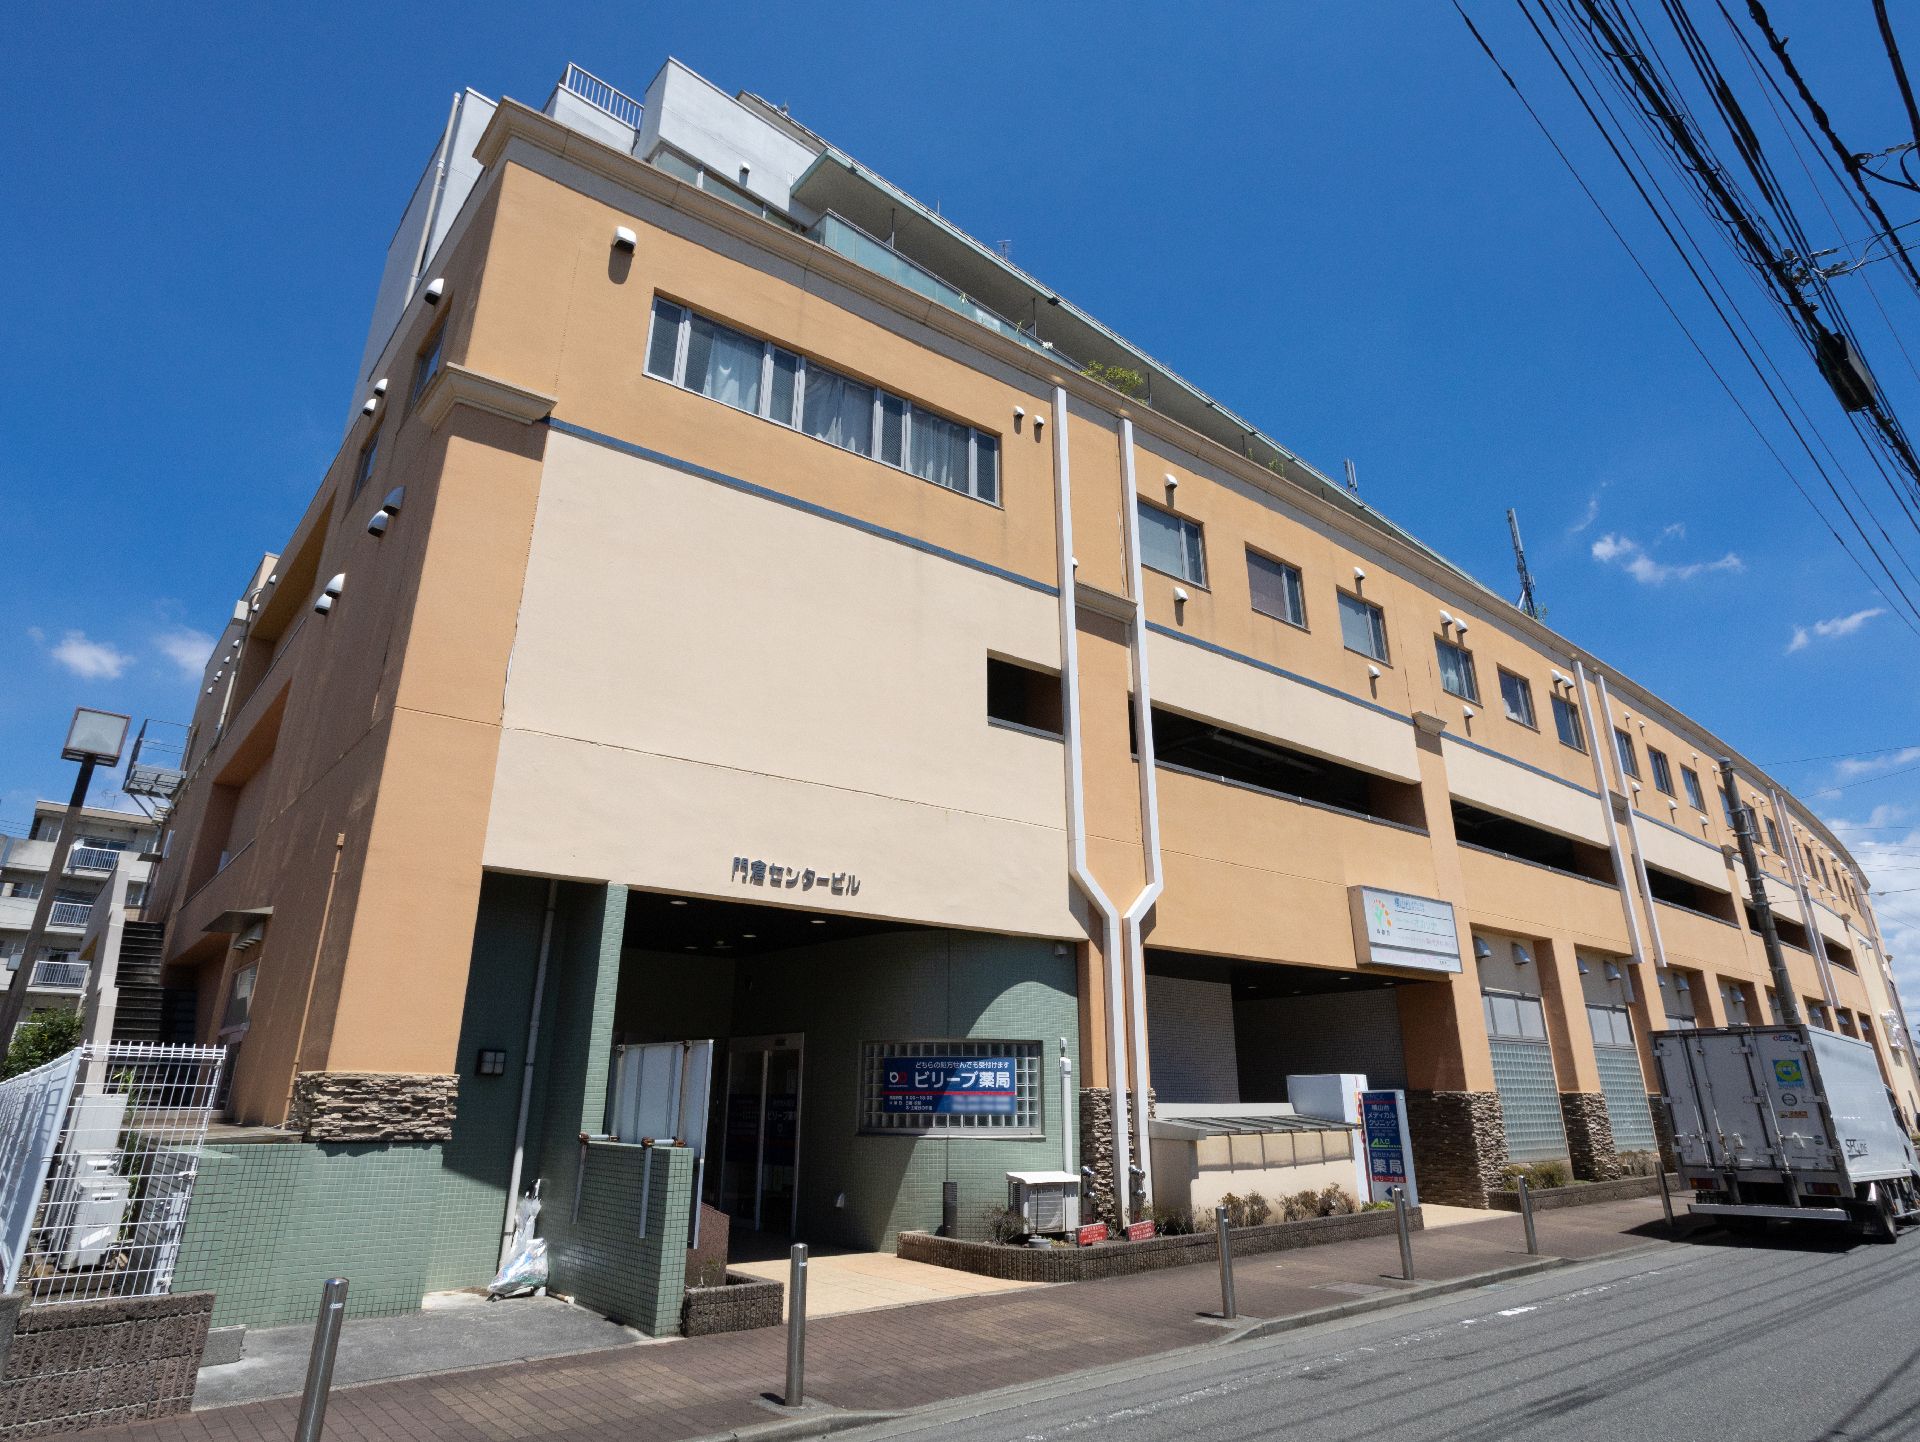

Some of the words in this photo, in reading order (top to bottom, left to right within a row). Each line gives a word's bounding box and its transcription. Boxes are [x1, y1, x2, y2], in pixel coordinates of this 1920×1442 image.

[732, 857, 860, 896] 門倉センタービル
[914, 1071, 1011, 1088] ビリーブ薬局
[1373, 1158, 1403, 1174] 薬局
